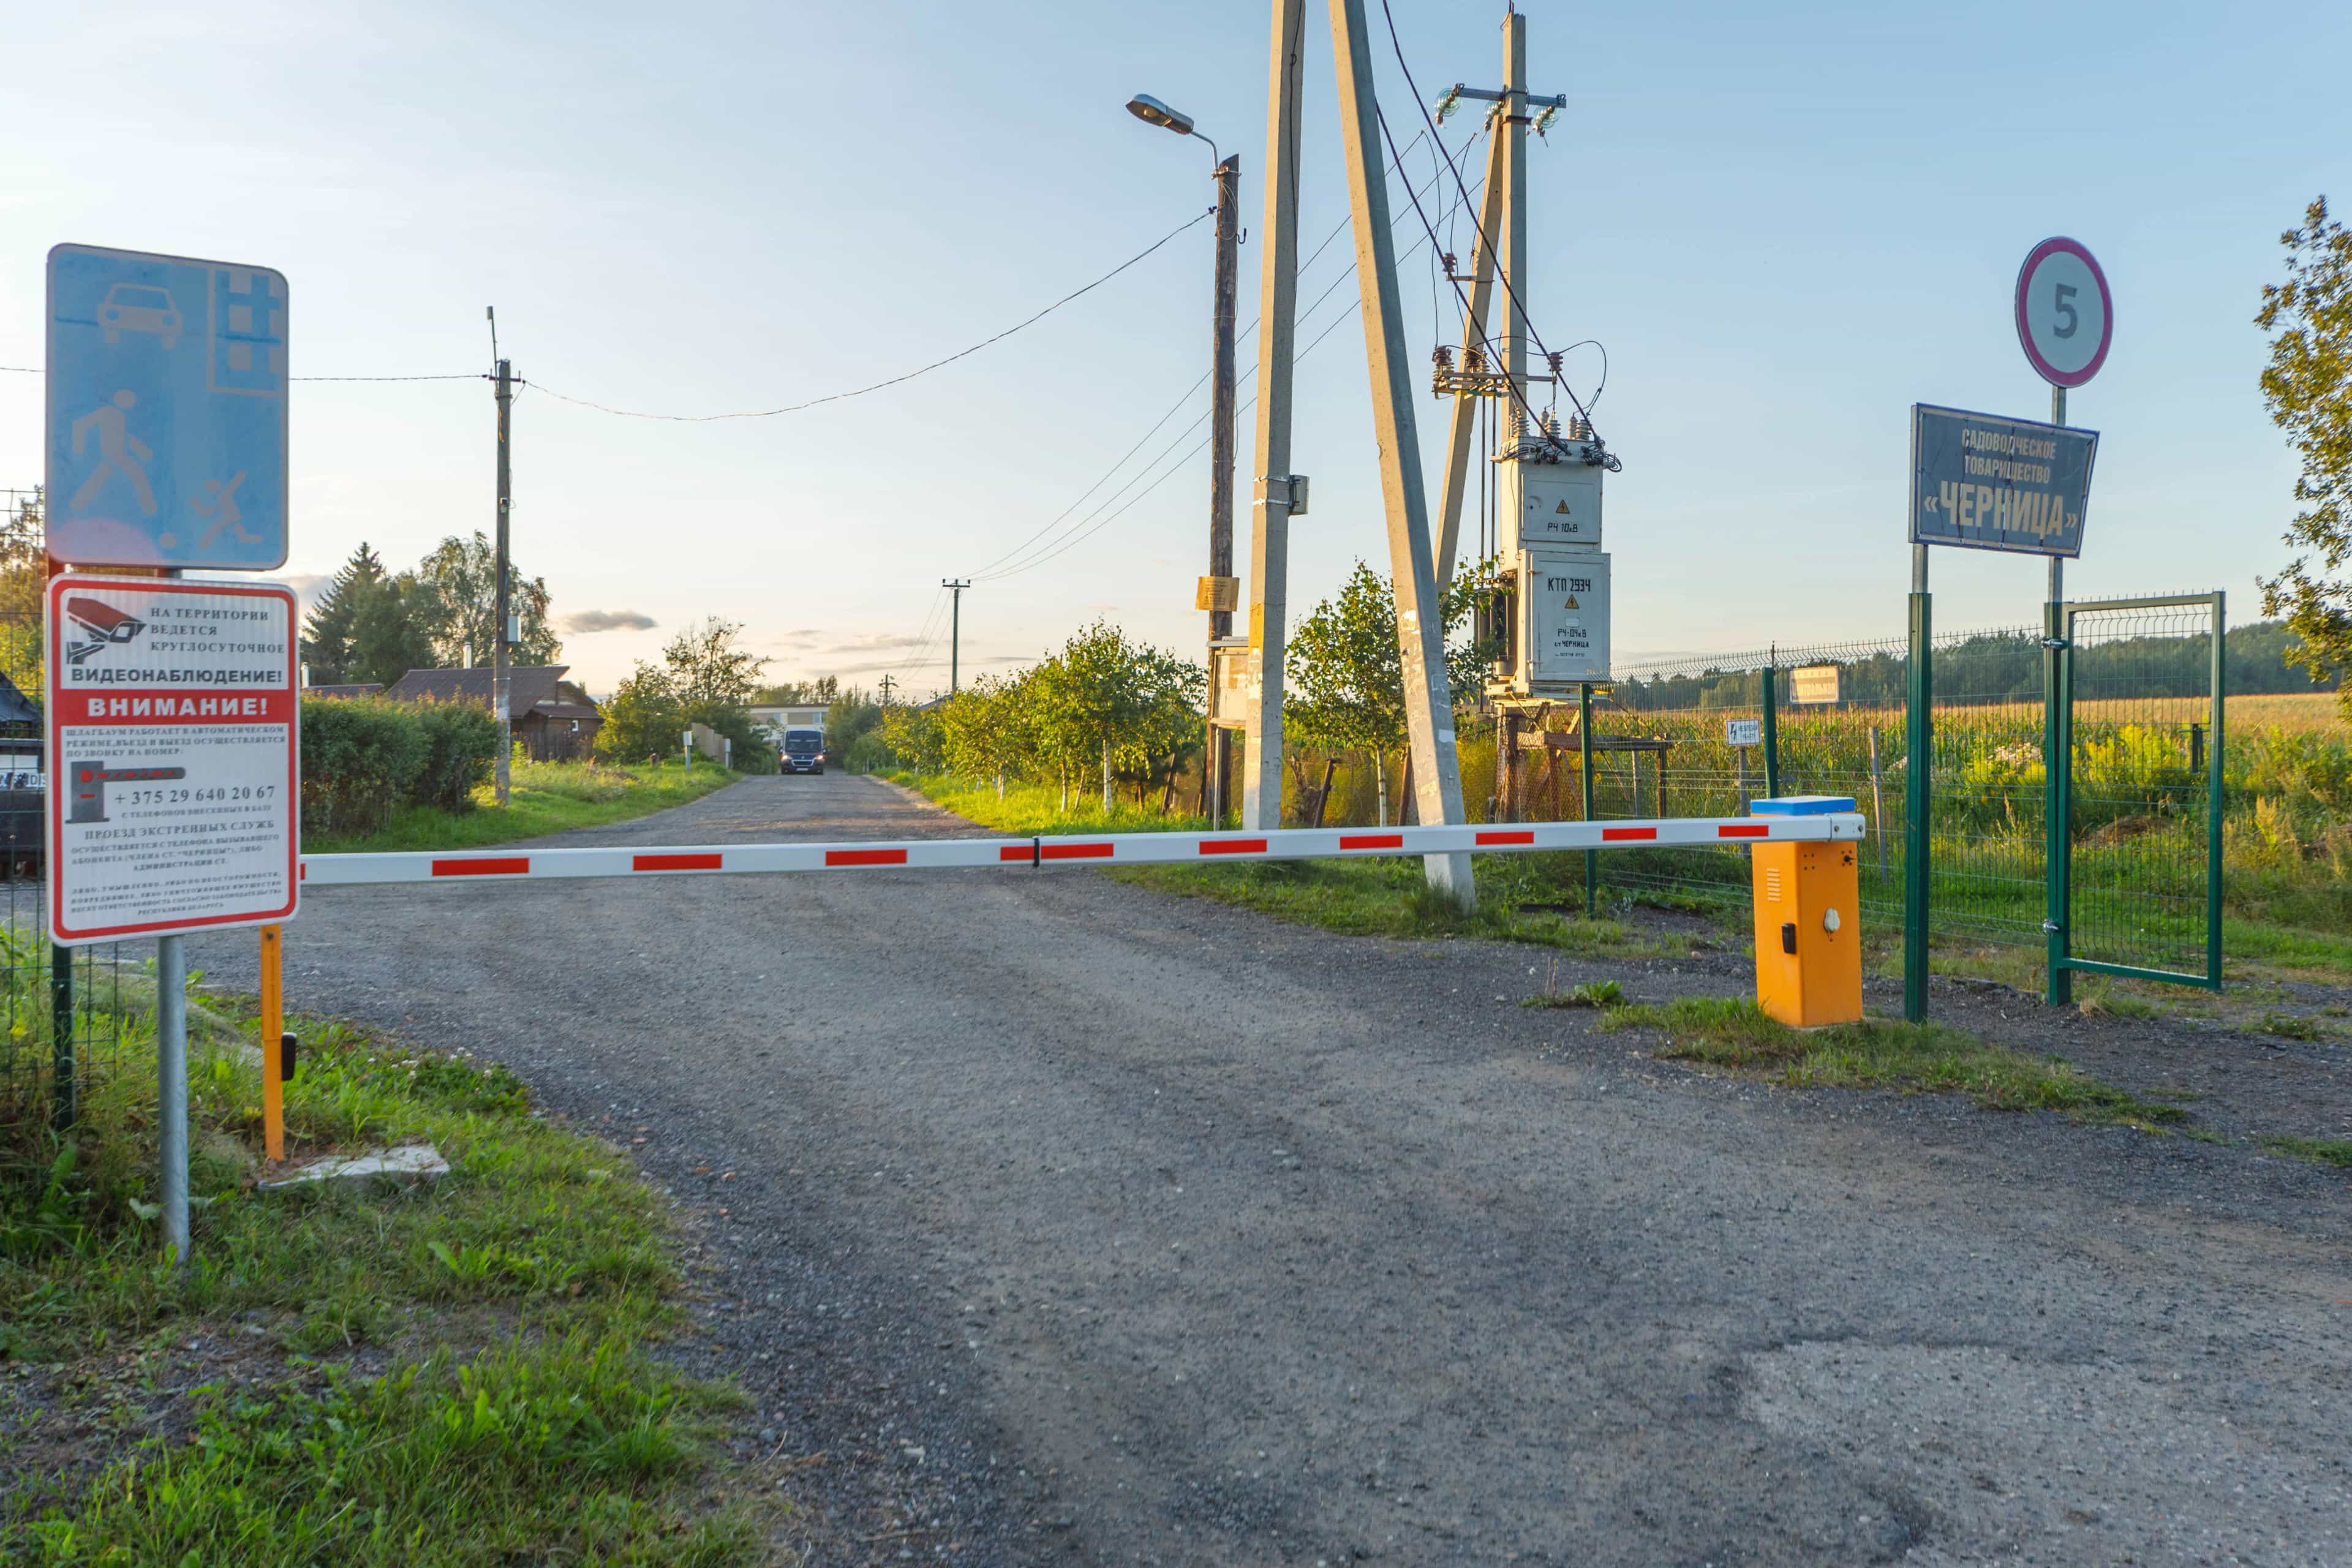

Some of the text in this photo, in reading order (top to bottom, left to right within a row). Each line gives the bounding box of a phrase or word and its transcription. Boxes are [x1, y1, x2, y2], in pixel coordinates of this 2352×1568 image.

[2054, 282, 2078, 339] 5
[1962, 428, 2057, 460] САДОВОДЧЕСКОЕ
[1965, 455, 2051, 484] ТОВАРИЩЕСТВО
[1924, 480, 2078, 538] «ЧЕРНИЦА»
[1548, 578, 1591, 592] КТП 2934
[151, 608, 268, 620] НА ТЕРРИТОРИИ
[151, 624, 217, 636] ВЕДЕТСЯ
[151, 641, 285, 654] КРУГЛОСУТОЧНОЕ
[72, 668, 282, 684] ВИДЕОНАБЛЮДЕНИЕ!
[88, 698, 268, 717] ВНИМАНИЕ!
[115, 785, 275, 805] + 375 29 640 20 67
[130, 809, 186, 818] ТЕЛЕФОНОВ
[85, 820, 275, 840] ПРОЕЗД ЭКСТРЕННЫХ СЛУЖБ
